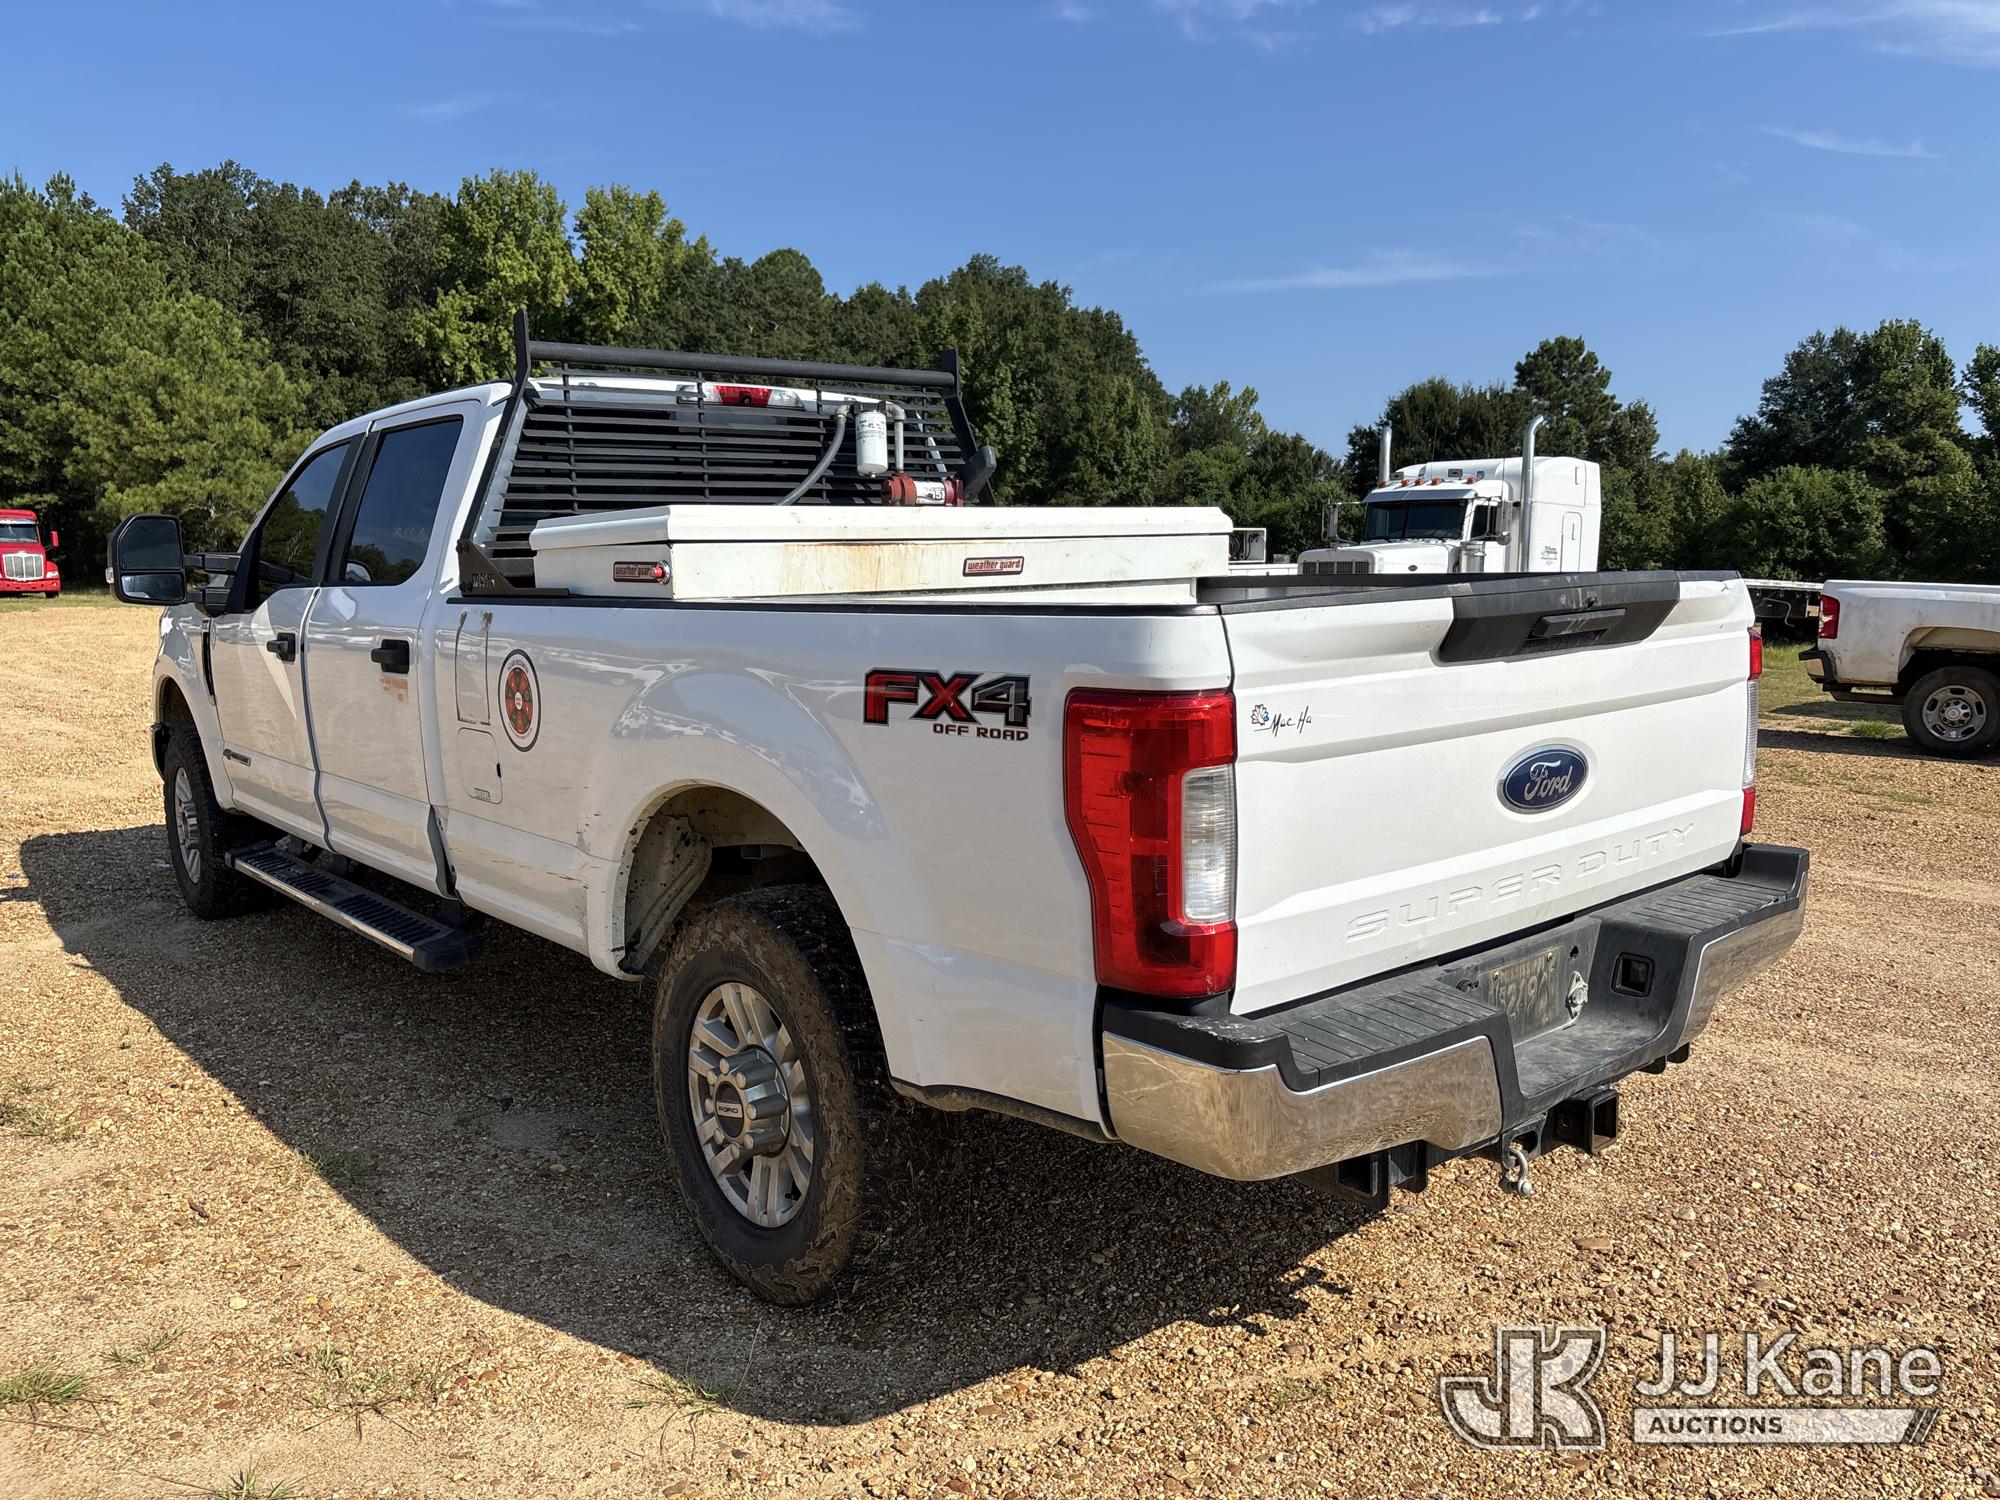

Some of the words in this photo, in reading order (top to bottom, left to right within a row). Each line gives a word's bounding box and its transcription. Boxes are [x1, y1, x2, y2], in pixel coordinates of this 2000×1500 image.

[967, 561, 998, 570] weather
[999, 560, 1021, 571] guard
[863, 668, 1032, 727] FX4
[933, 723, 969, 735] OFF
[976, 727, 1029, 741] ROAD
[1524, 760, 1573, 801] Ford
[1345, 863, 1562, 942] SUPER
[1576, 822, 1696, 878] DUTY
[719, 1106, 739, 1114] FORD
